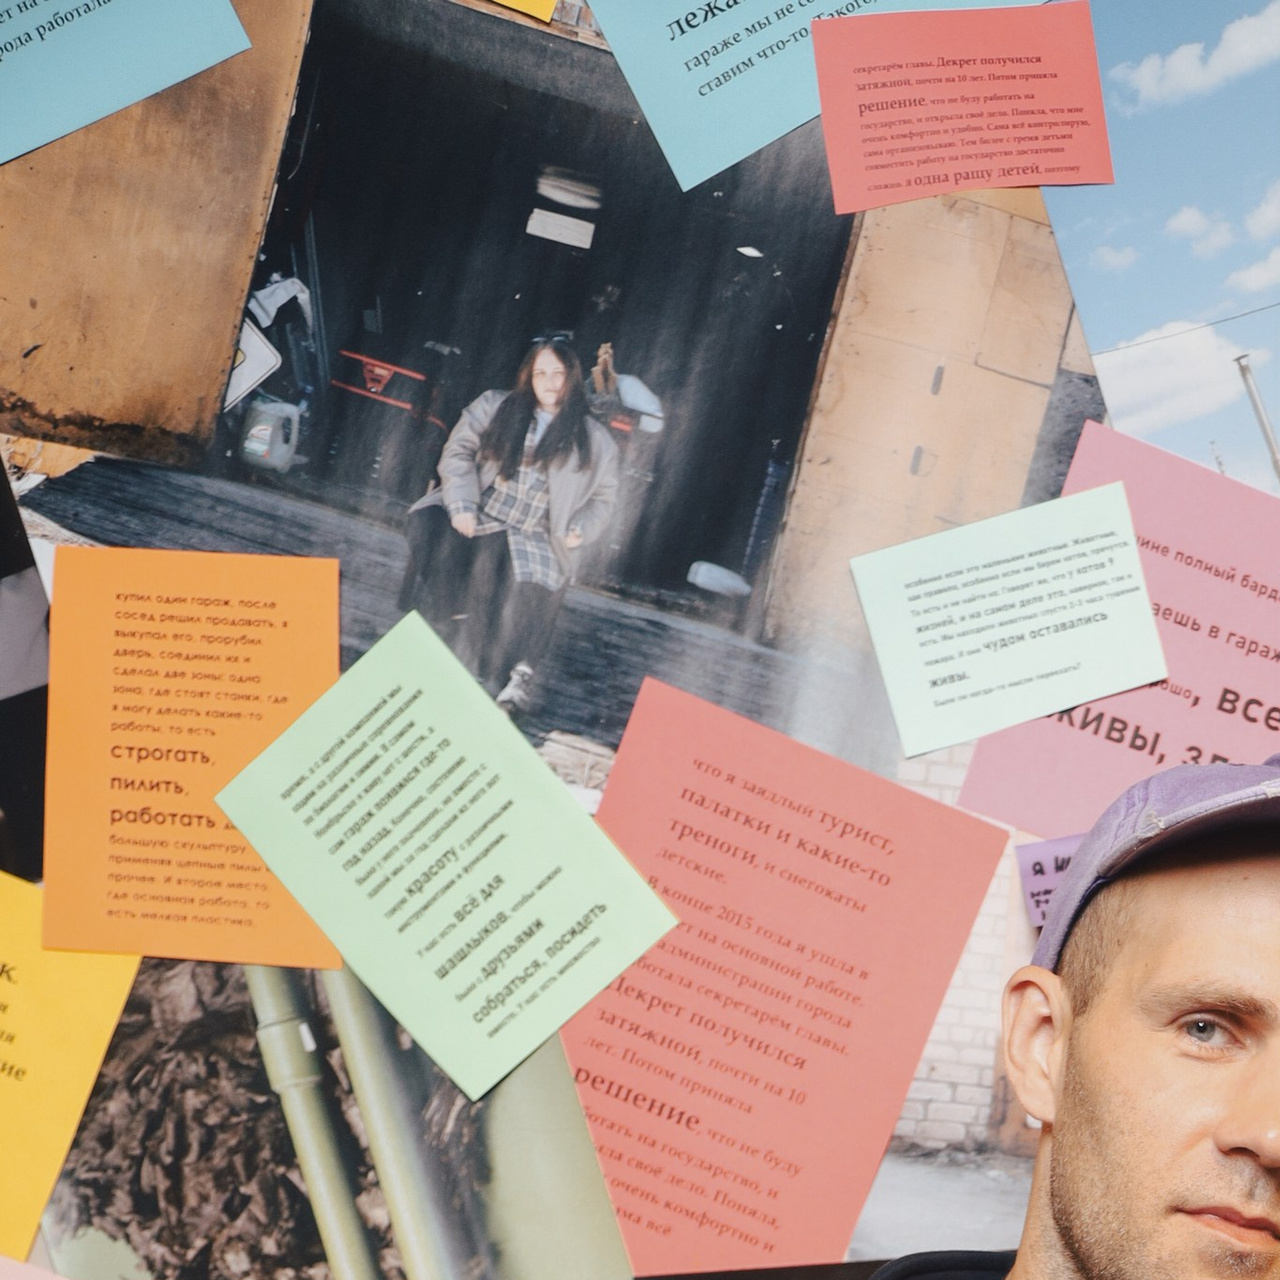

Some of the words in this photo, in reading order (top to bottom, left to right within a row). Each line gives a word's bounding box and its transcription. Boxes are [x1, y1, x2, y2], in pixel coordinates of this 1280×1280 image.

[683, 30, 742, 72] гараже
[745, 18, 771, 40] мы
[936, 56, 977, 69] Декрет
[979, 55, 1042, 68] получился
[699, 57, 756, 96] ставим
[913, 172, 950, 186] одна
[1173, 550, 1236, 583] полный
[110, 744, 210, 764] строгать,
[110, 776, 184, 794] пилить,
[110, 806, 216, 829] работать
[680, 787, 771, 835] палатки
[795, 837, 891, 886] какие-то
[819, 811, 894, 855] турист,
[404, 846, 459, 897] красоту
[480, 918, 544, 980] друзьями
[544, 903, 607, 958] посидеть
